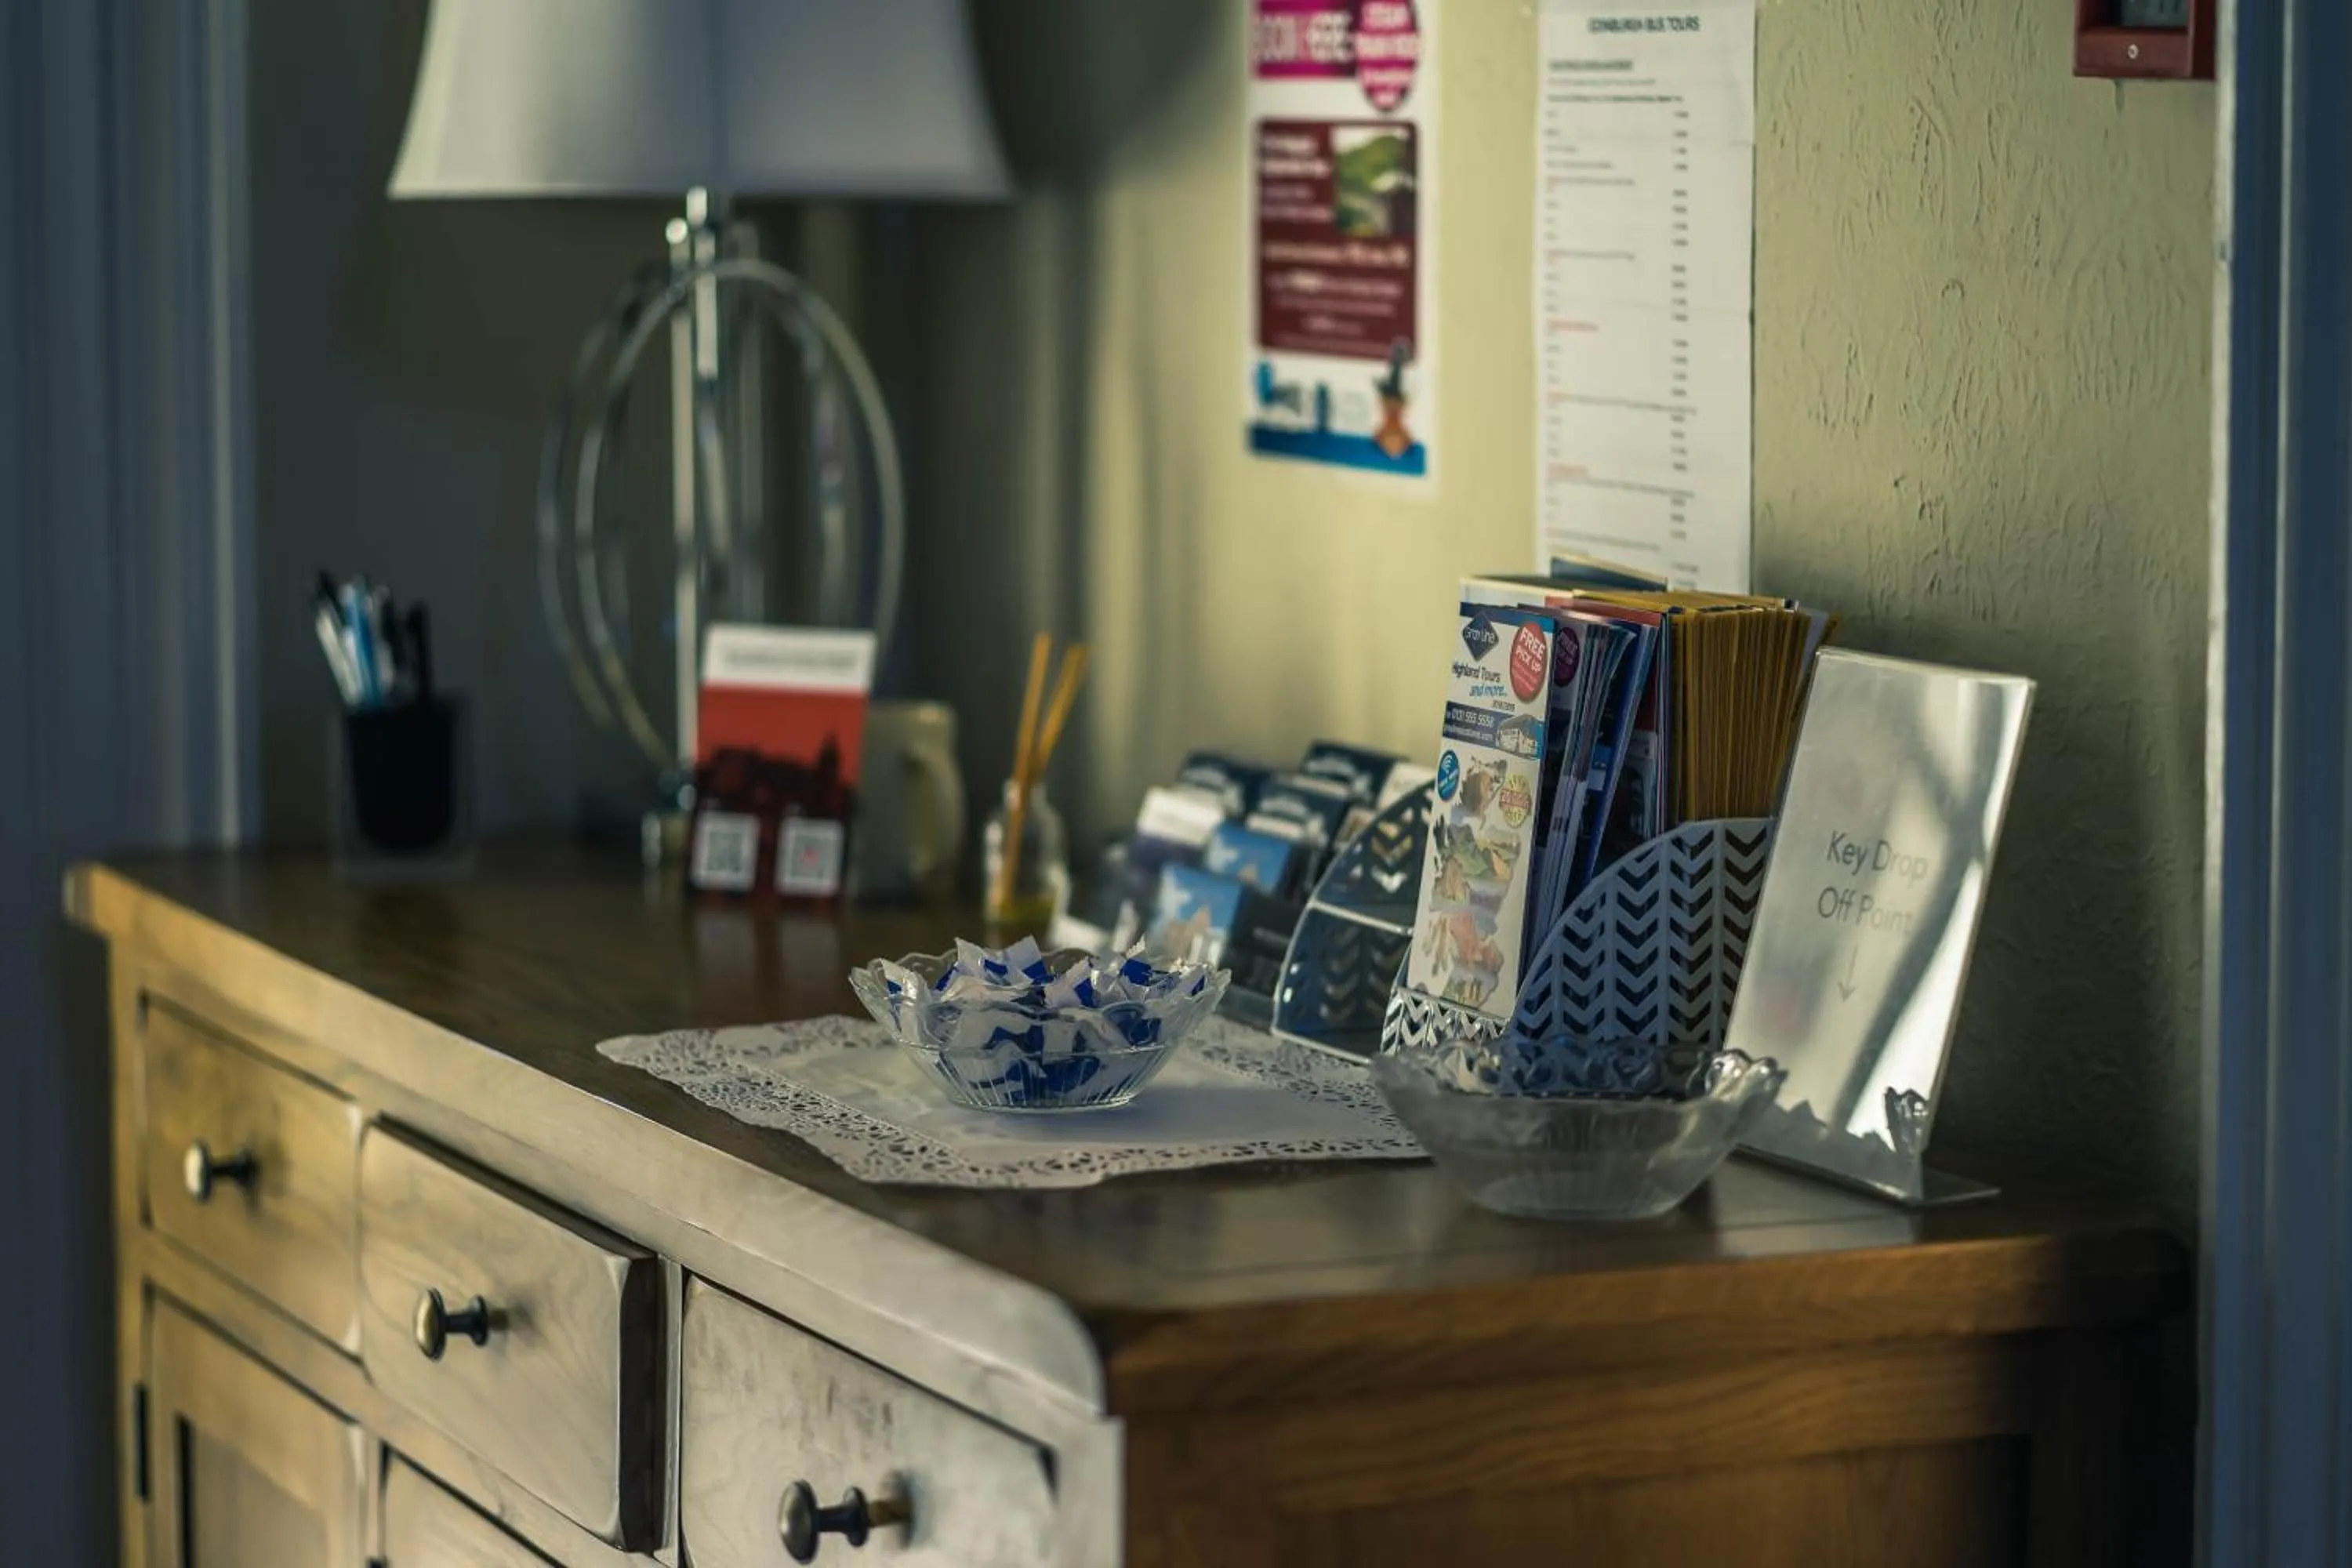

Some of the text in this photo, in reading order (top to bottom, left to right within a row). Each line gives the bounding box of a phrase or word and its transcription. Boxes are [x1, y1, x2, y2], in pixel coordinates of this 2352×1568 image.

[1667, 16, 1700, 31] TOURS
[1519, 627, 1546, 660] FREE
[1827, 829, 1928, 888] Key Drop
[1817, 886, 1856, 922] Off
